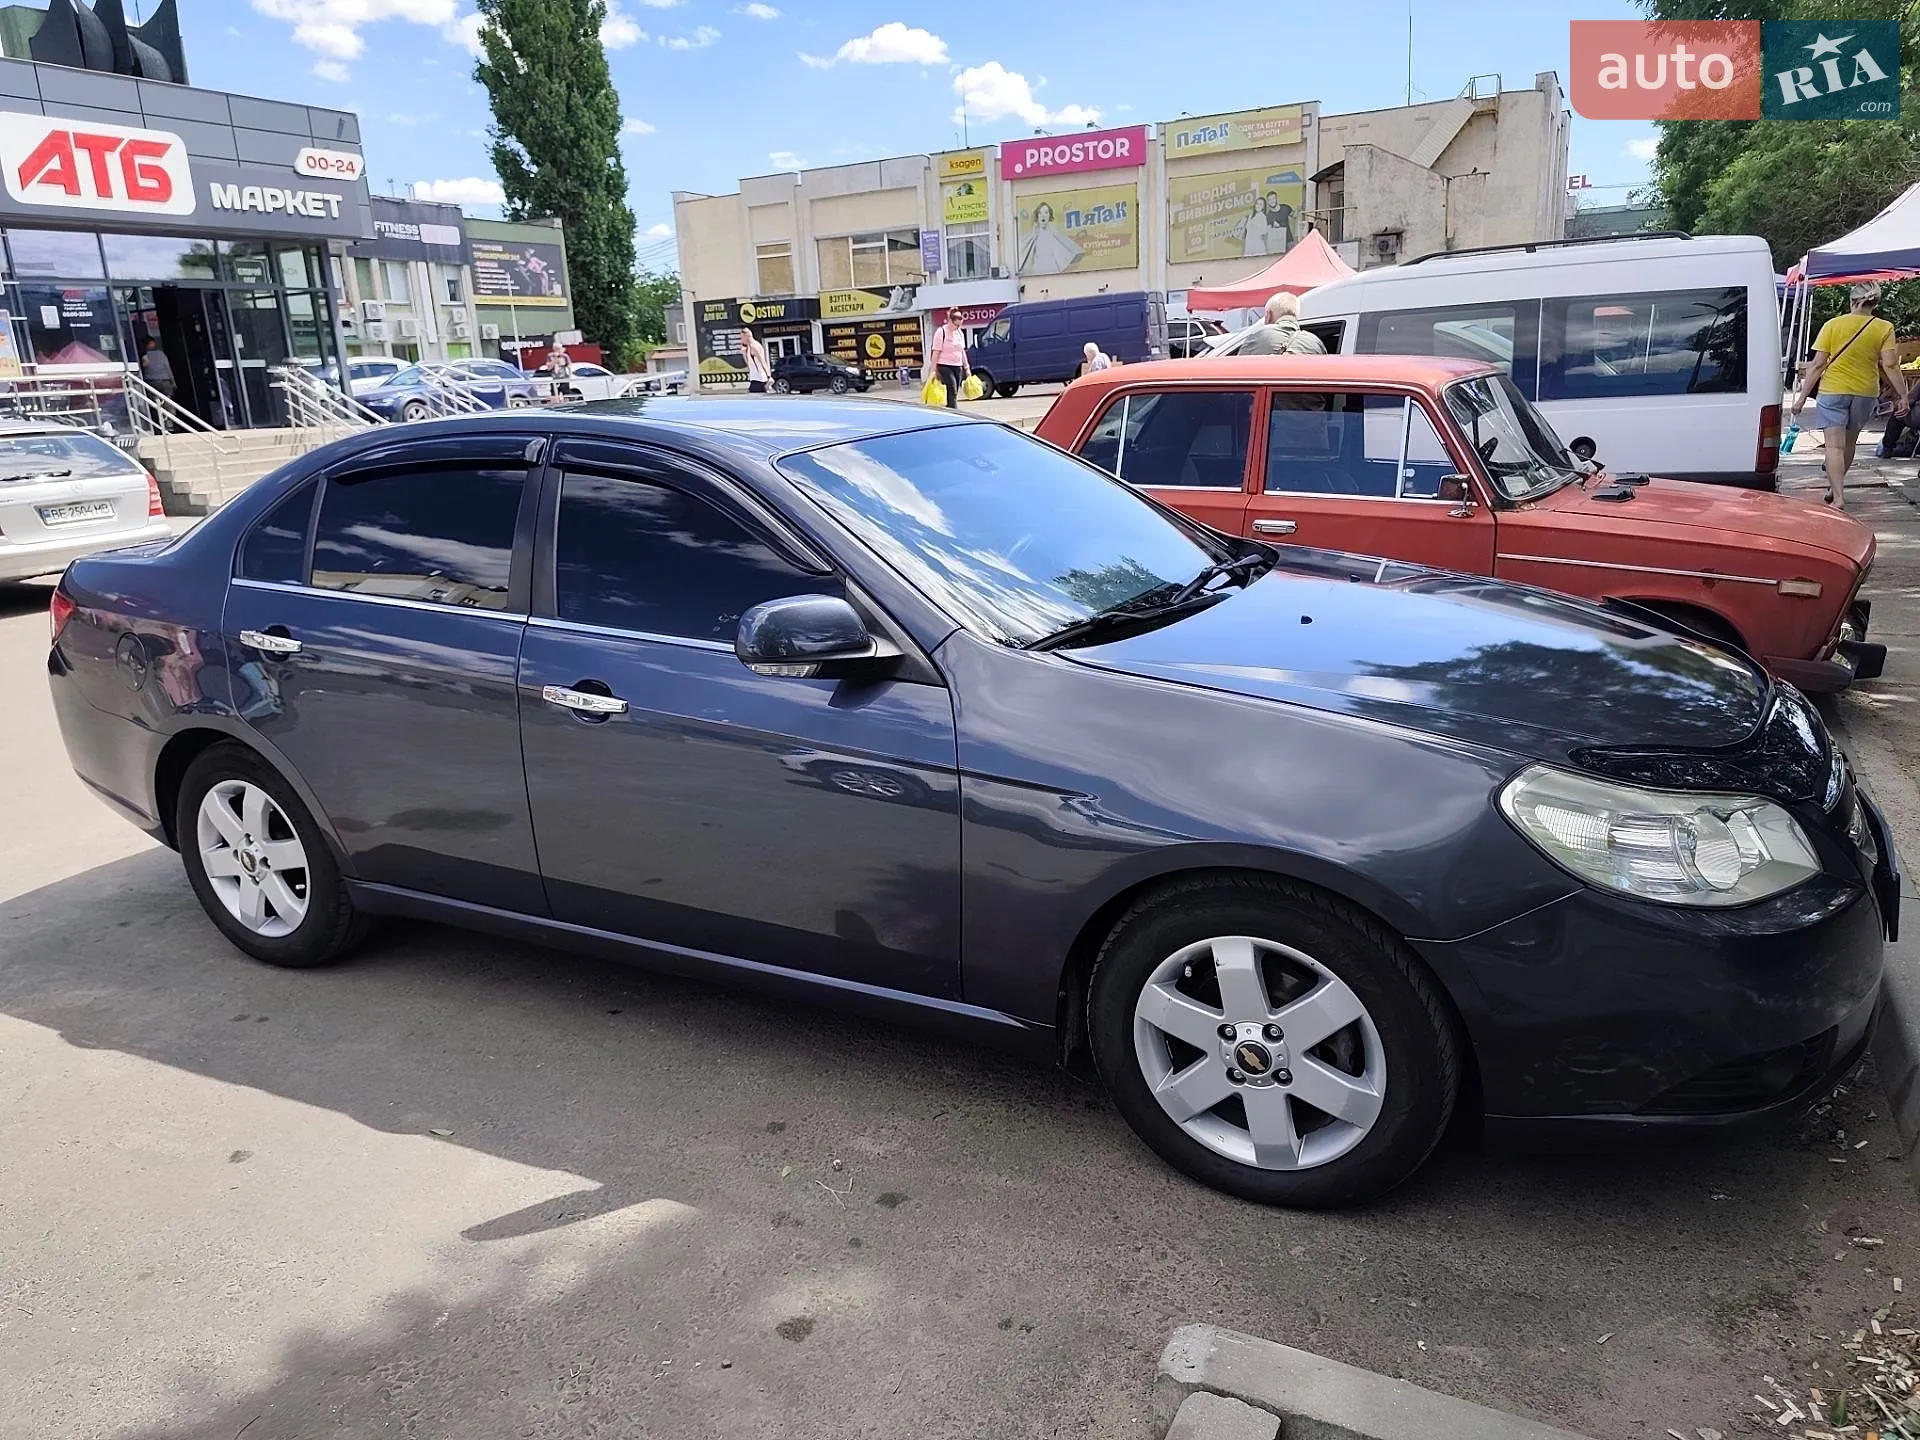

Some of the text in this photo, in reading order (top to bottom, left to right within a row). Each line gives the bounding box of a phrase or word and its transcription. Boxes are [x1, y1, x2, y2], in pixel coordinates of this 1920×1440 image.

[18, 130, 173, 203] АТБ
[305, 155, 357, 175] 00-24
[949, 158, 981, 169] ksagen
[210, 182, 344, 219] МАРКЕТ
[374, 221, 419, 235] FITNESS
[829, 294, 852, 304] ВЗУТТЯ
[756, 304, 785, 319] OSTRIV
[829, 303, 864, 313] АКСЕСУАРИ
